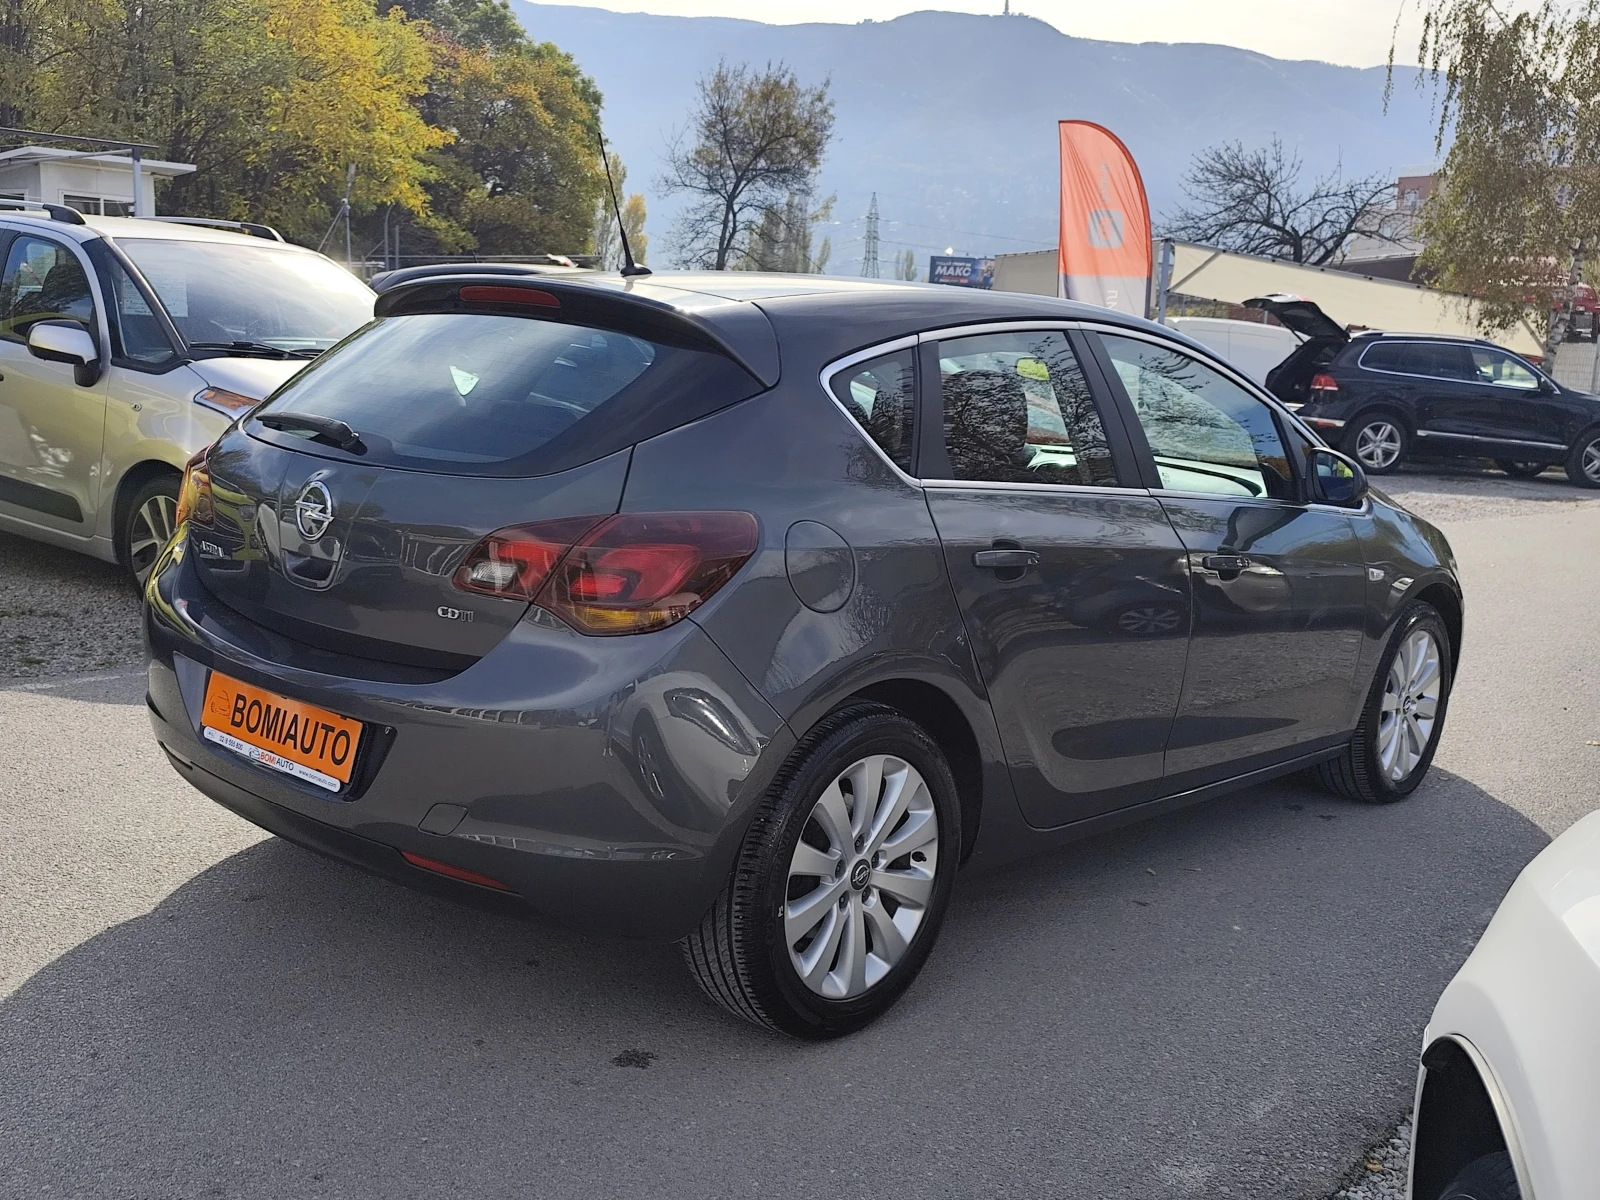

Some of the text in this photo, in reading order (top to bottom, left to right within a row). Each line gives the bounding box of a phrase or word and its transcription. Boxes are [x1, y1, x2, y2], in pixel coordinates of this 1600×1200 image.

[935, 265, 972, 277] МАКС
[437, 606, 474, 622] CDTI
[230, 693, 351, 766] BOMIAUTO
